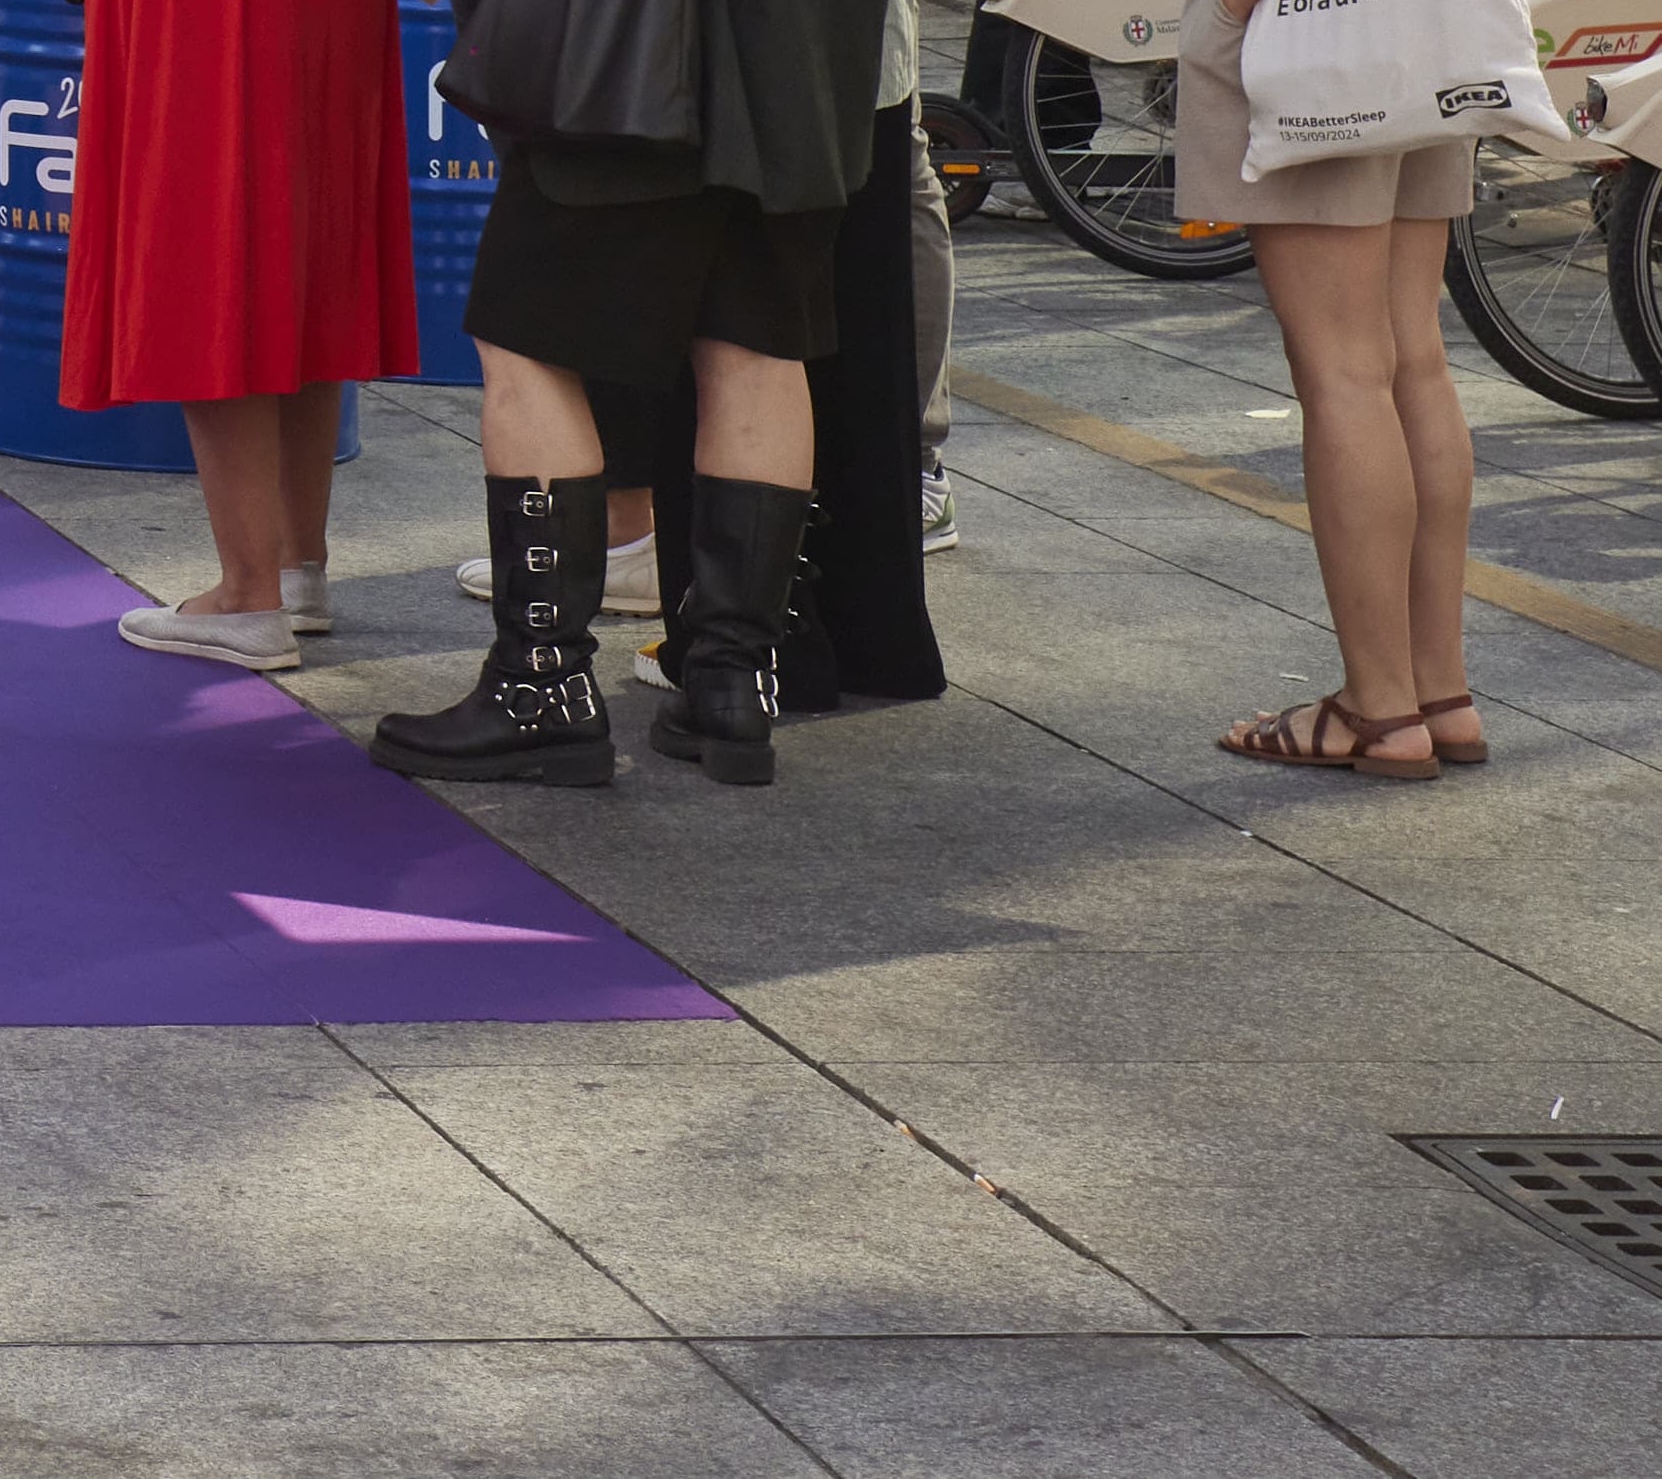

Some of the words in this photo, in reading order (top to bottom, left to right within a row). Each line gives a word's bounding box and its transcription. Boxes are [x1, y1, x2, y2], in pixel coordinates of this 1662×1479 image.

[1442, 86, 1506, 110] IKEA
[1276, 107, 1387, 130] #IKEABetterSleep
[1278, 127, 1362, 144] 13-15/09/2024
